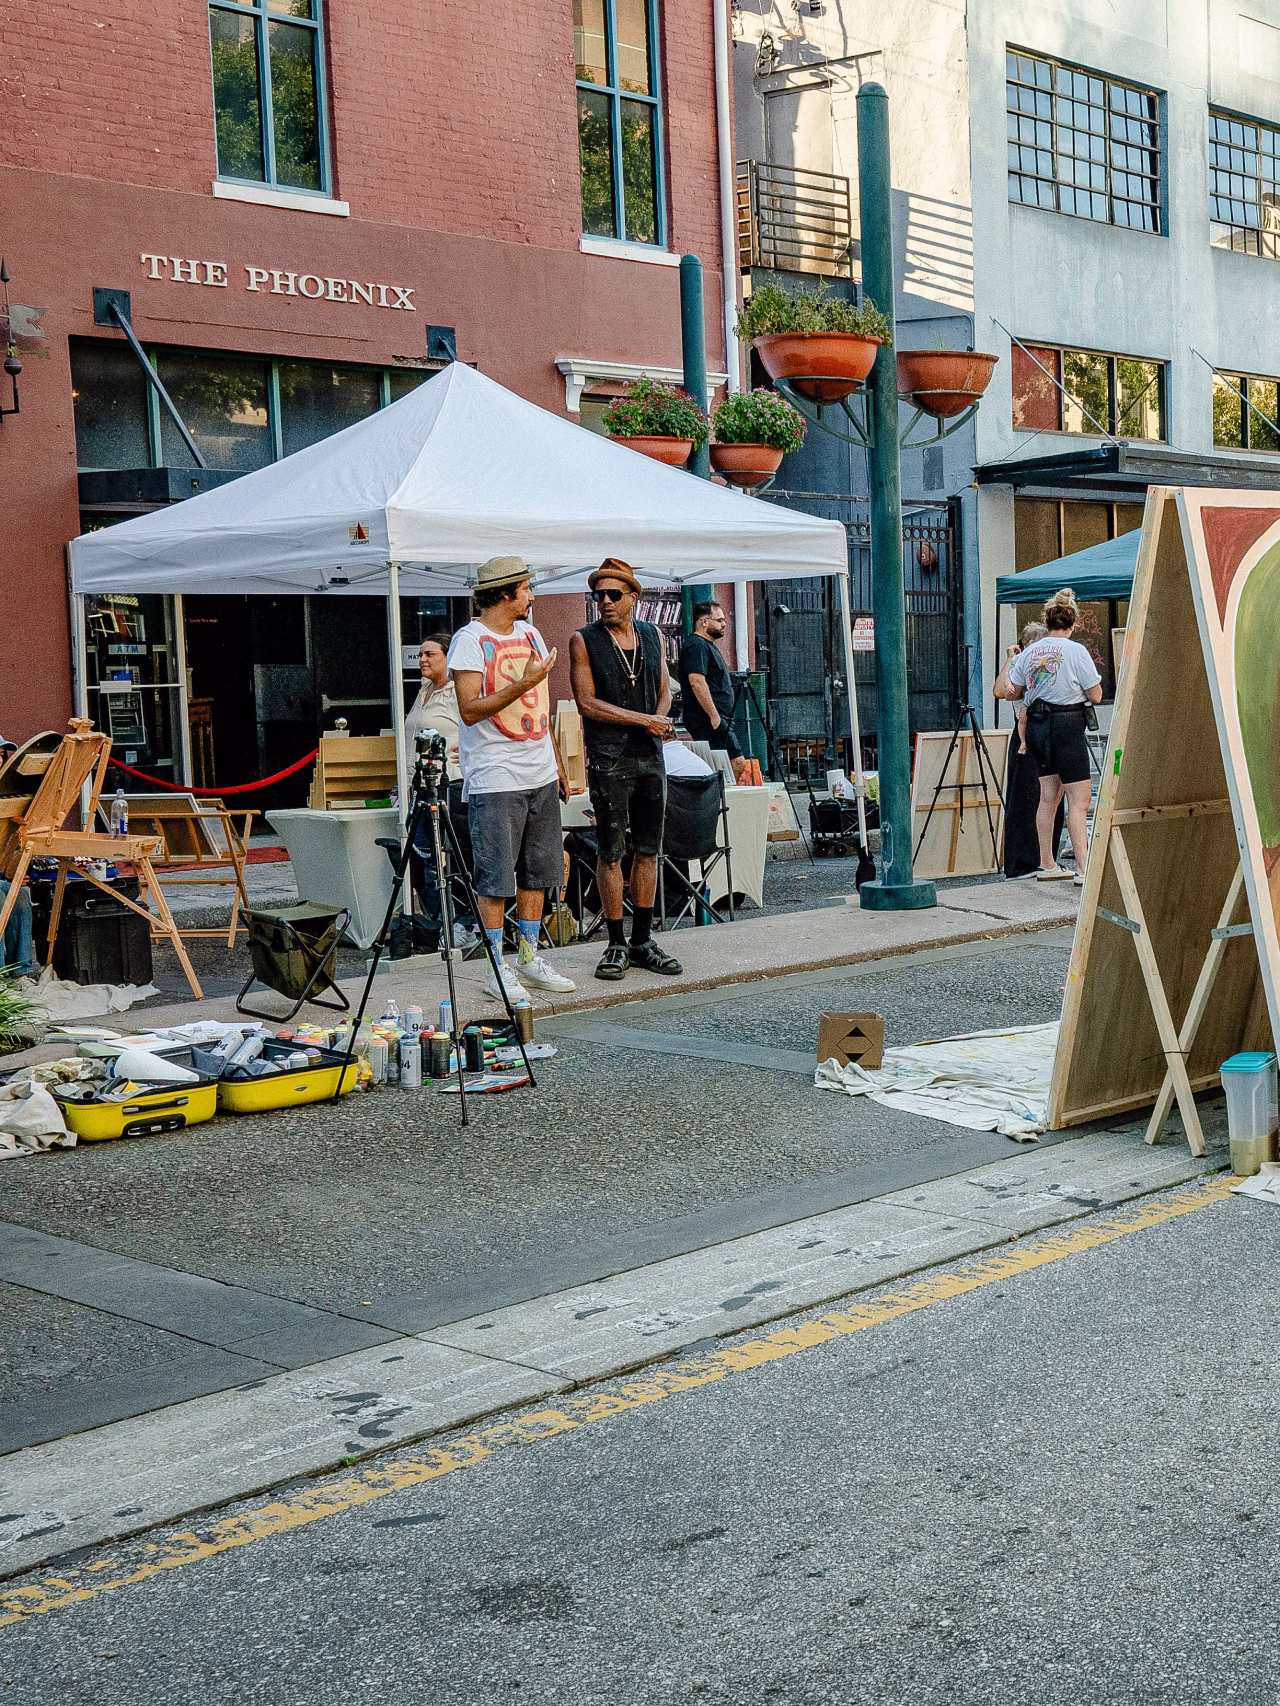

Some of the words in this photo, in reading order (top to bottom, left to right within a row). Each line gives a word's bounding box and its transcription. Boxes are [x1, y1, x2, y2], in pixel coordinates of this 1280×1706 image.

[140, 253, 228, 287] THE
[245, 267, 417, 311] PHOENIX
[116, 645, 139, 654] ATM
